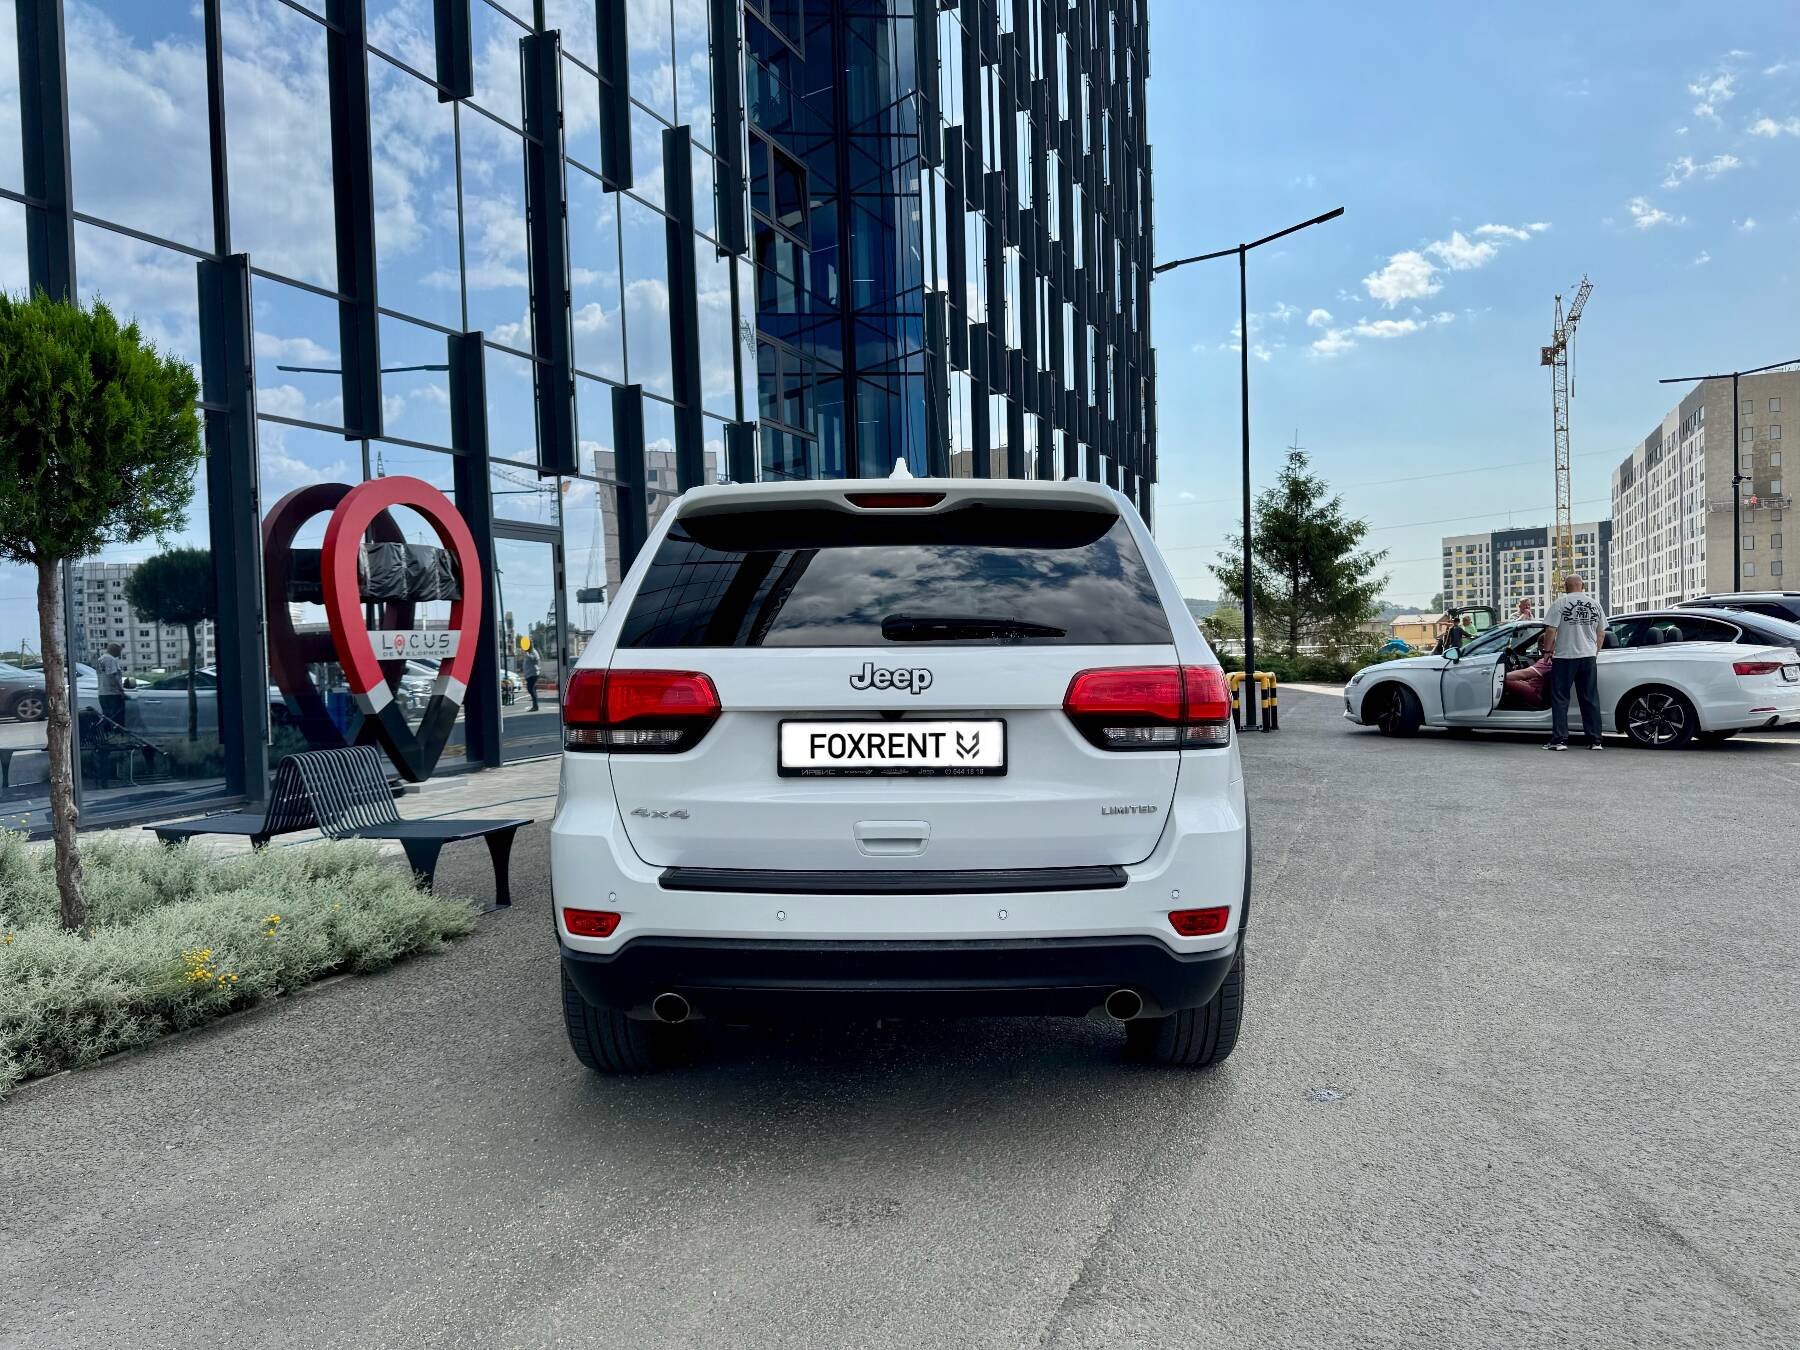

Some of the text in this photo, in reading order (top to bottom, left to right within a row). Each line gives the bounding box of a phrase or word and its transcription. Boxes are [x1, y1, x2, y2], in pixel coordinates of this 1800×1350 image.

[382, 634, 449, 650] LOCUS
[849, 662, 932, 695] Jeep
[810, 733, 946, 759] FOXRENT
[631, 807, 690, 819] 4x4
[1101, 805, 1158, 815] LIMITED
